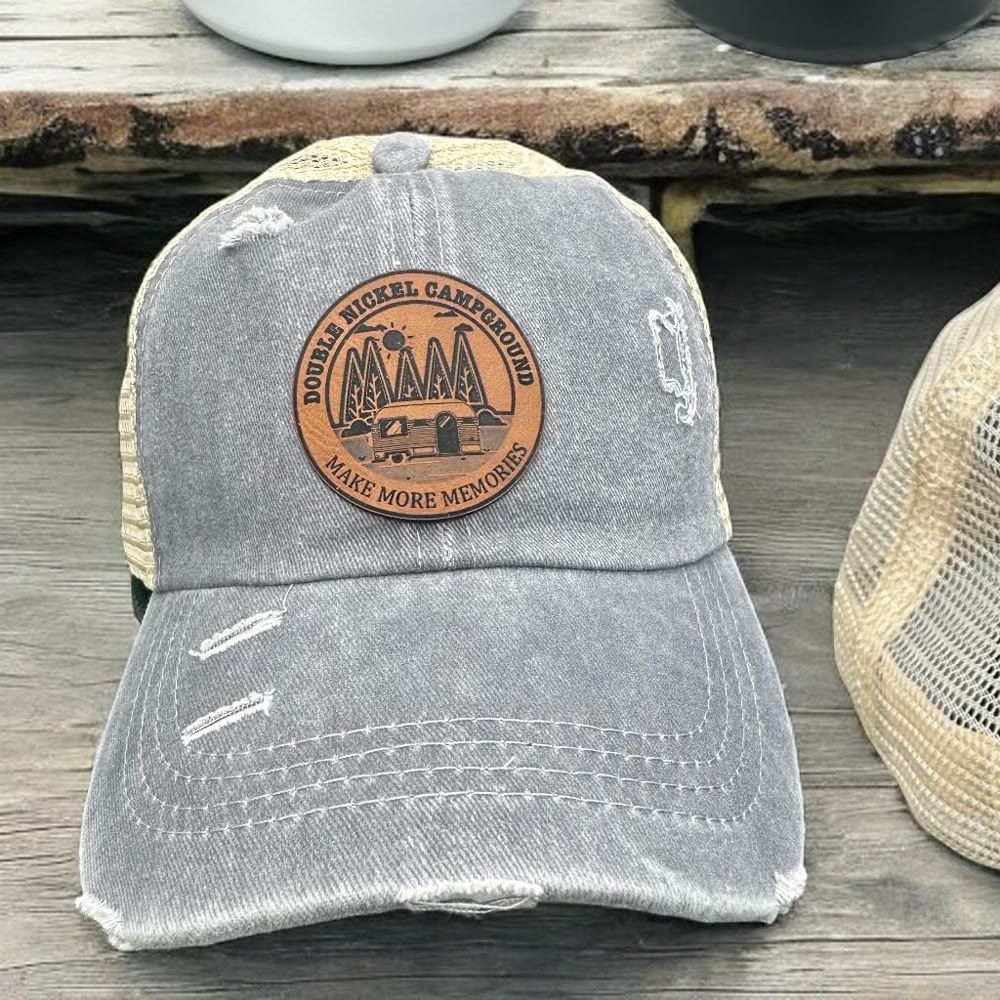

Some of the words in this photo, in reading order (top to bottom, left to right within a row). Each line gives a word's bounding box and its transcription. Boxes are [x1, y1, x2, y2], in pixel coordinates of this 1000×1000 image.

[304, 322, 344, 405] DOUBLE
[339, 281, 418, 323] NICKEL
[425, 281, 534, 386] CAMPGROUND
[324, 455, 376, 497] MAKE
[378, 486, 437, 508] MORE
[442, 442, 527, 508] MEMORIES
